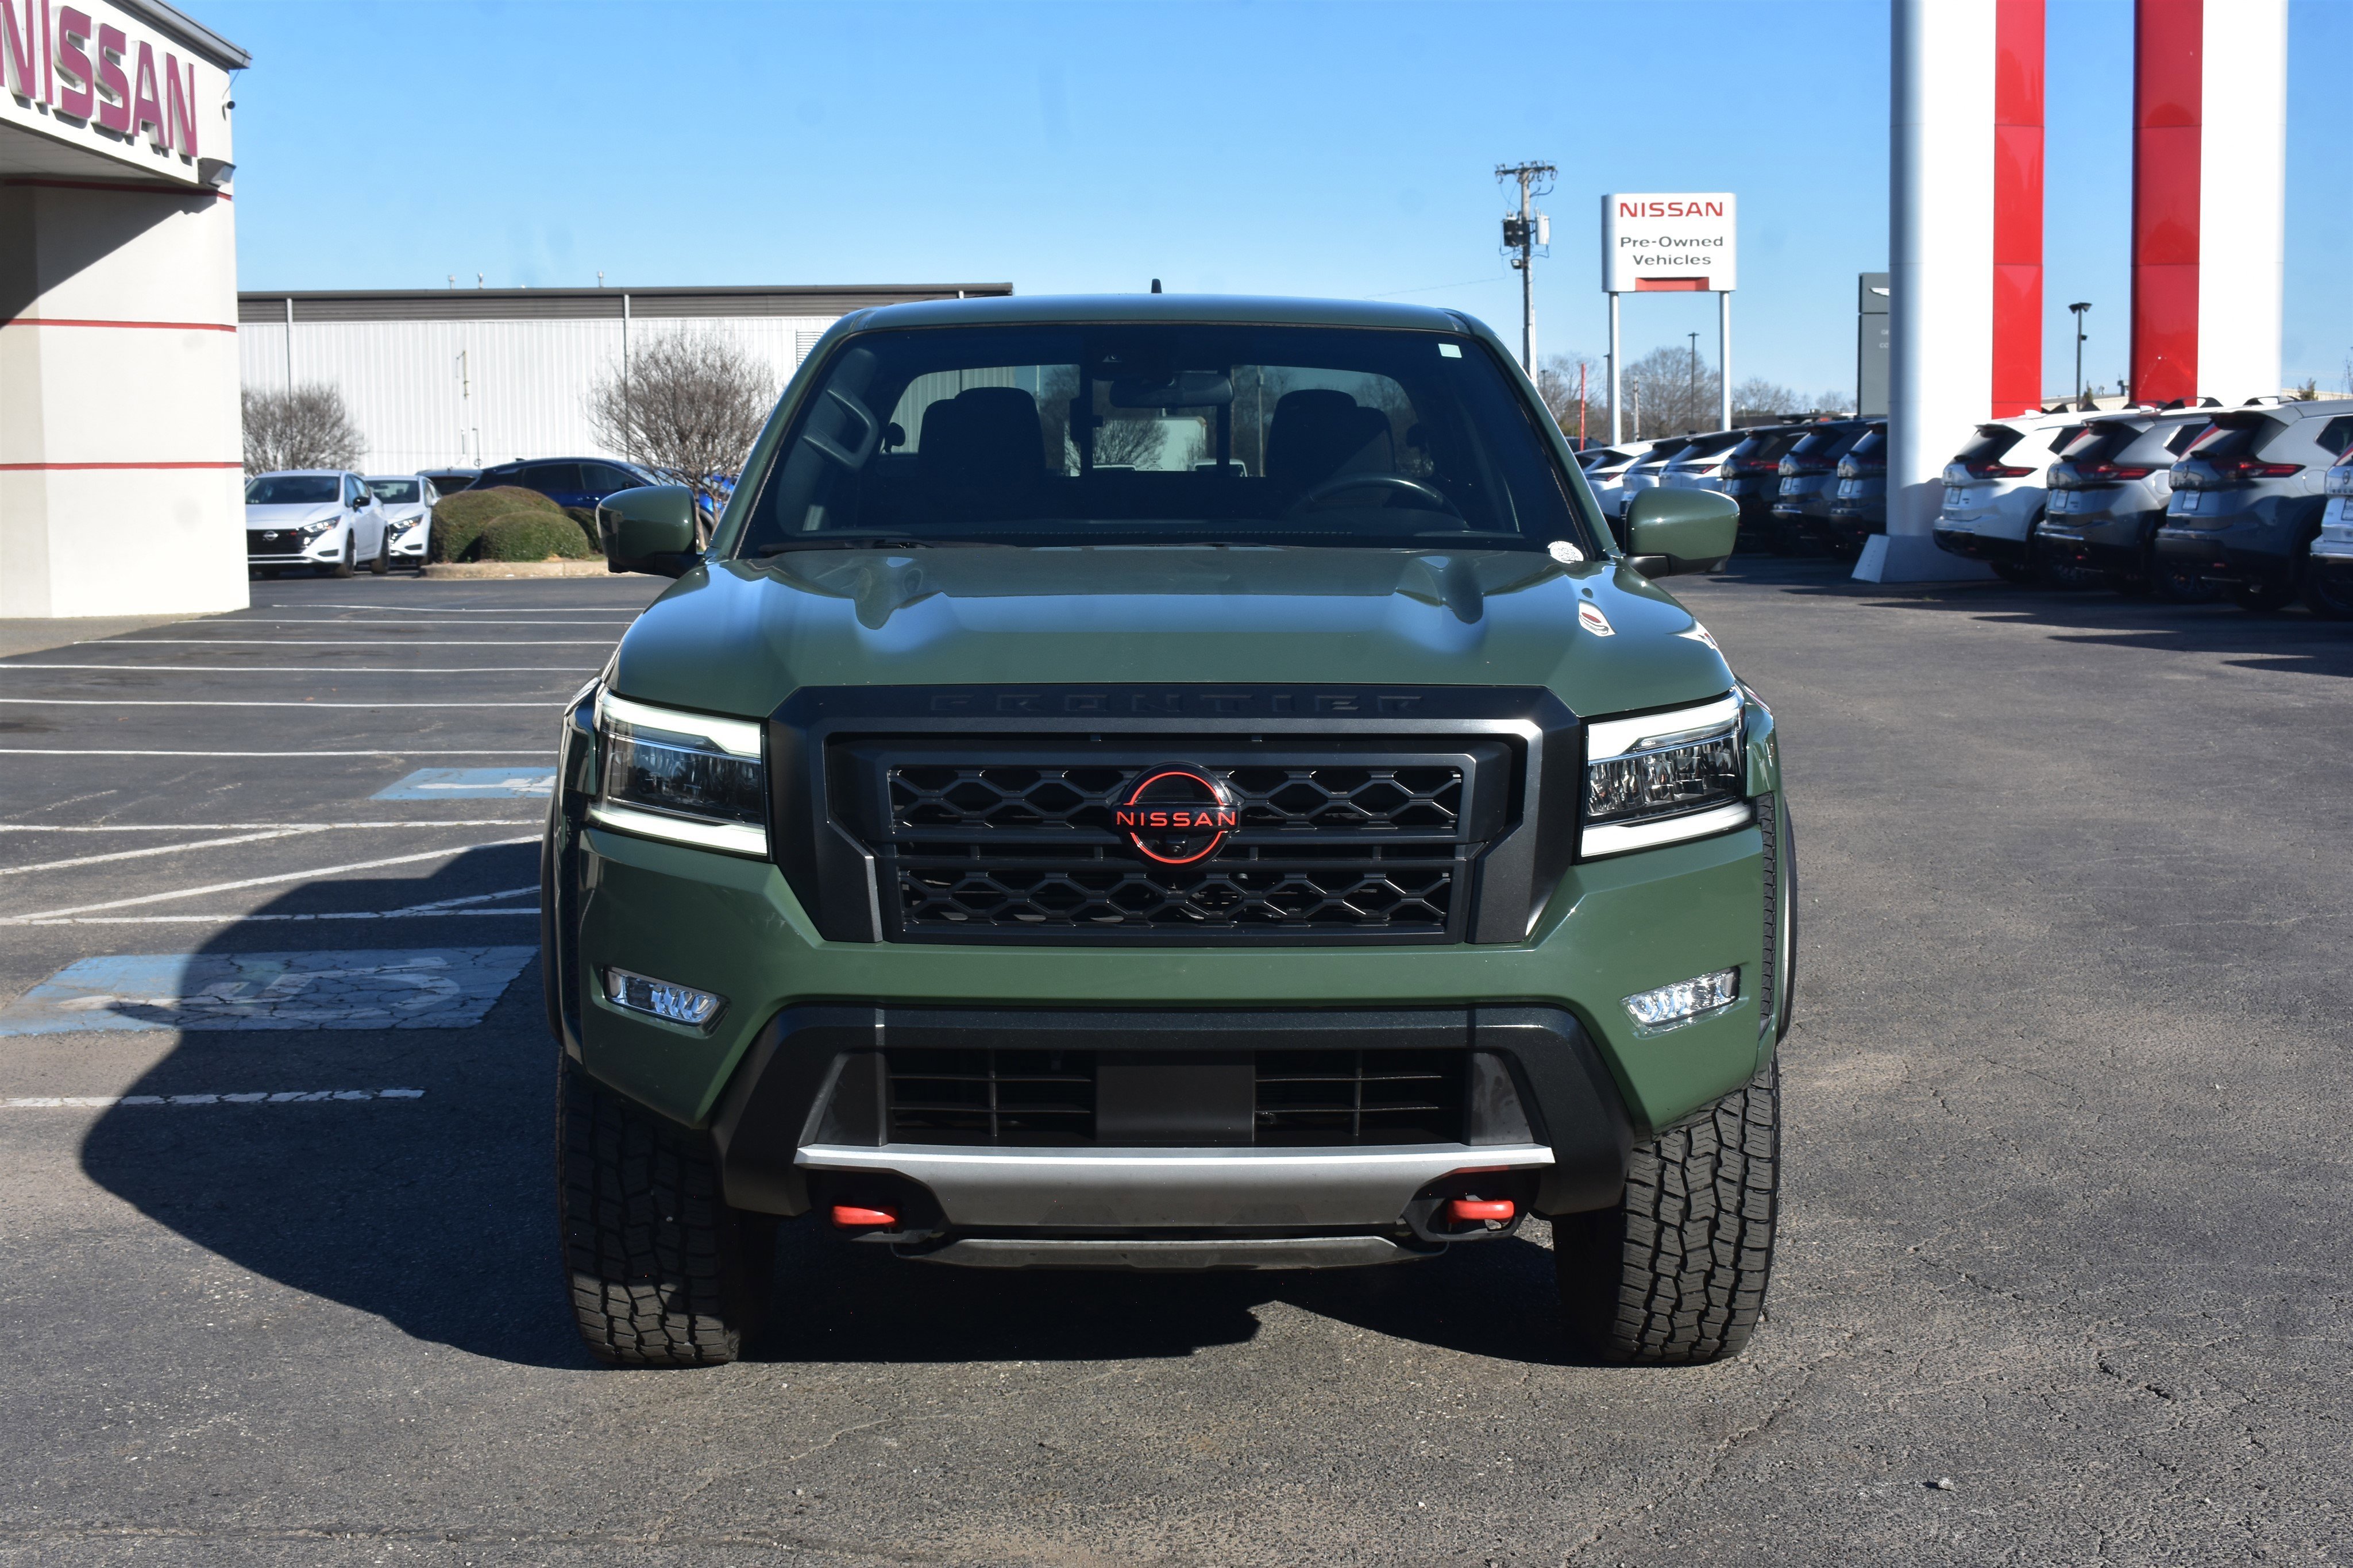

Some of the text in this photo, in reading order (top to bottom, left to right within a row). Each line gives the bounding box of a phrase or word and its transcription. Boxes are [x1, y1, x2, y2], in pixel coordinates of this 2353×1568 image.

[0, 0, 198, 157] NISSAN
[1620, 202, 1723, 217] NISSAN
[1620, 236, 1723, 248] Pre-Owned
[1633, 254, 1712, 265] Vehicles
[930, 693, 1424, 712] FRONTIER
[1116, 811, 1236, 827] NISSAN
